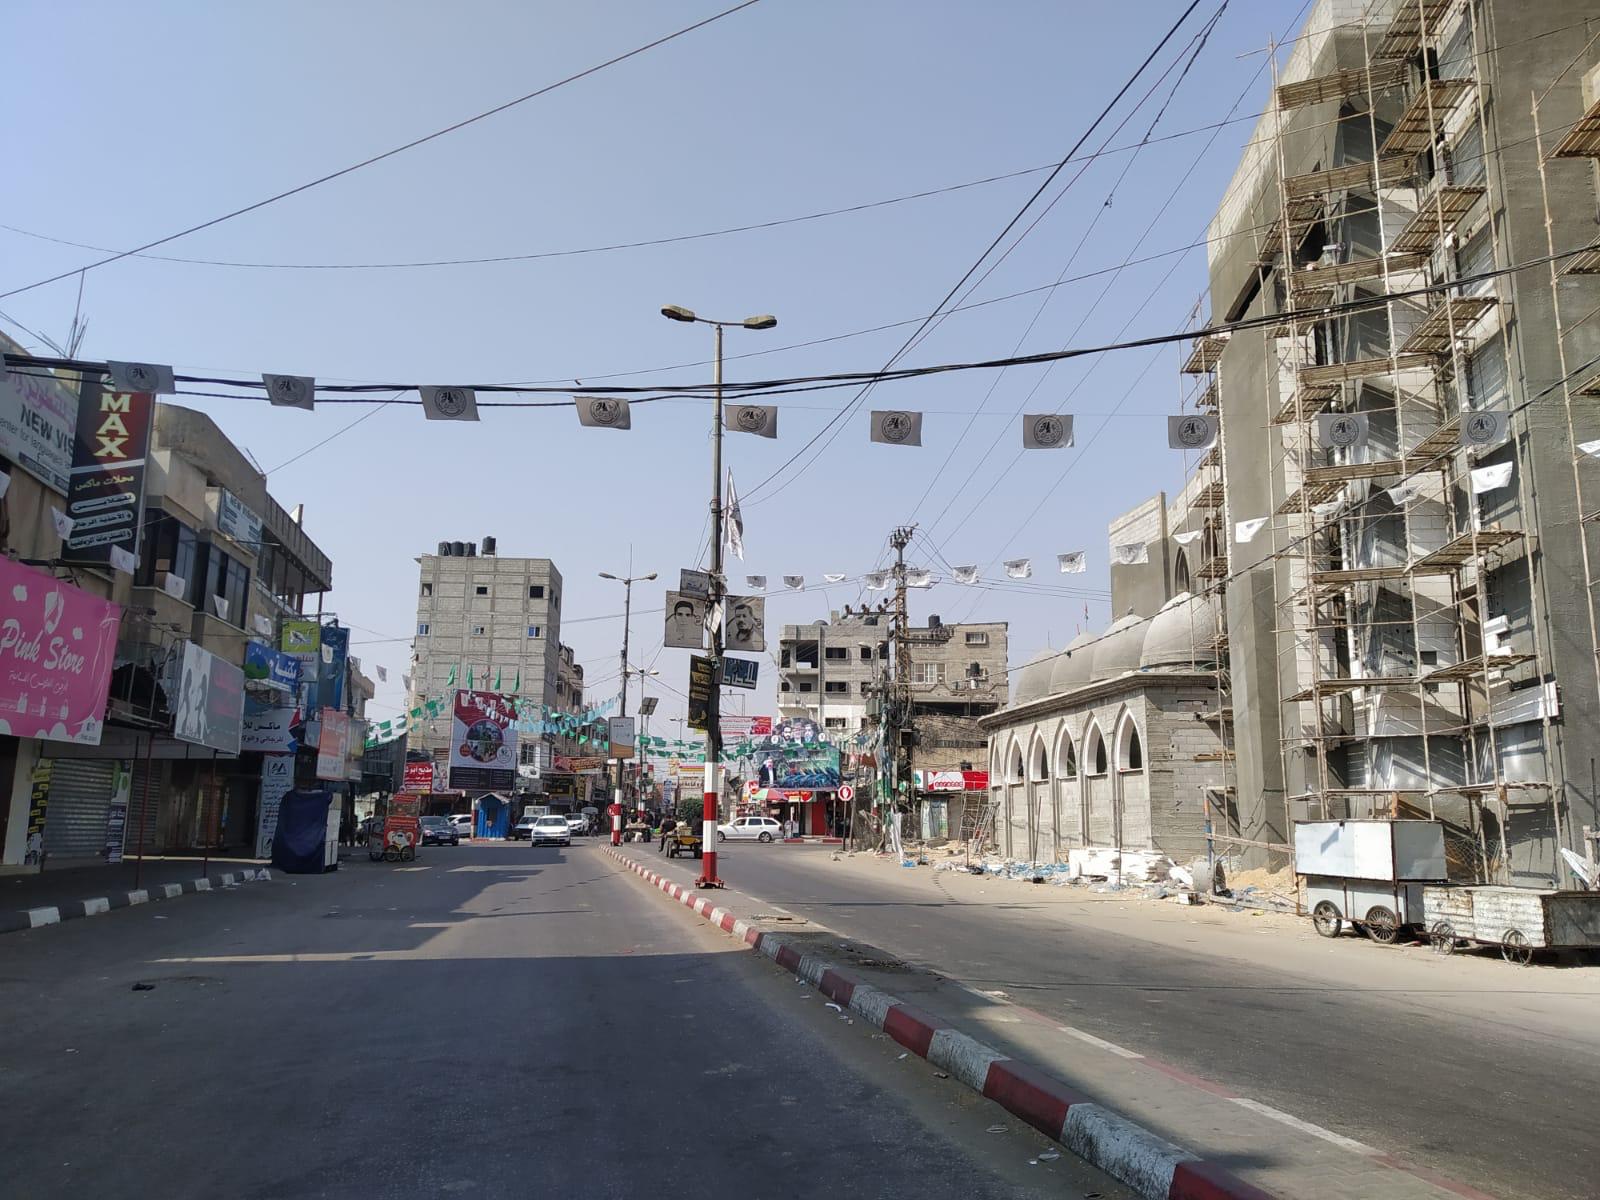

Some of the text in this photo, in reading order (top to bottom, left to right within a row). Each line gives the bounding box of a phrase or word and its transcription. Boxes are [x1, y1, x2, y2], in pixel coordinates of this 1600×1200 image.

[20, 404, 53, 441] NEW
[92, 392, 132, 457] MAX
[75, 474, 134, 491] محلات ماكس
[0, 618, 86, 674] Pink Store
